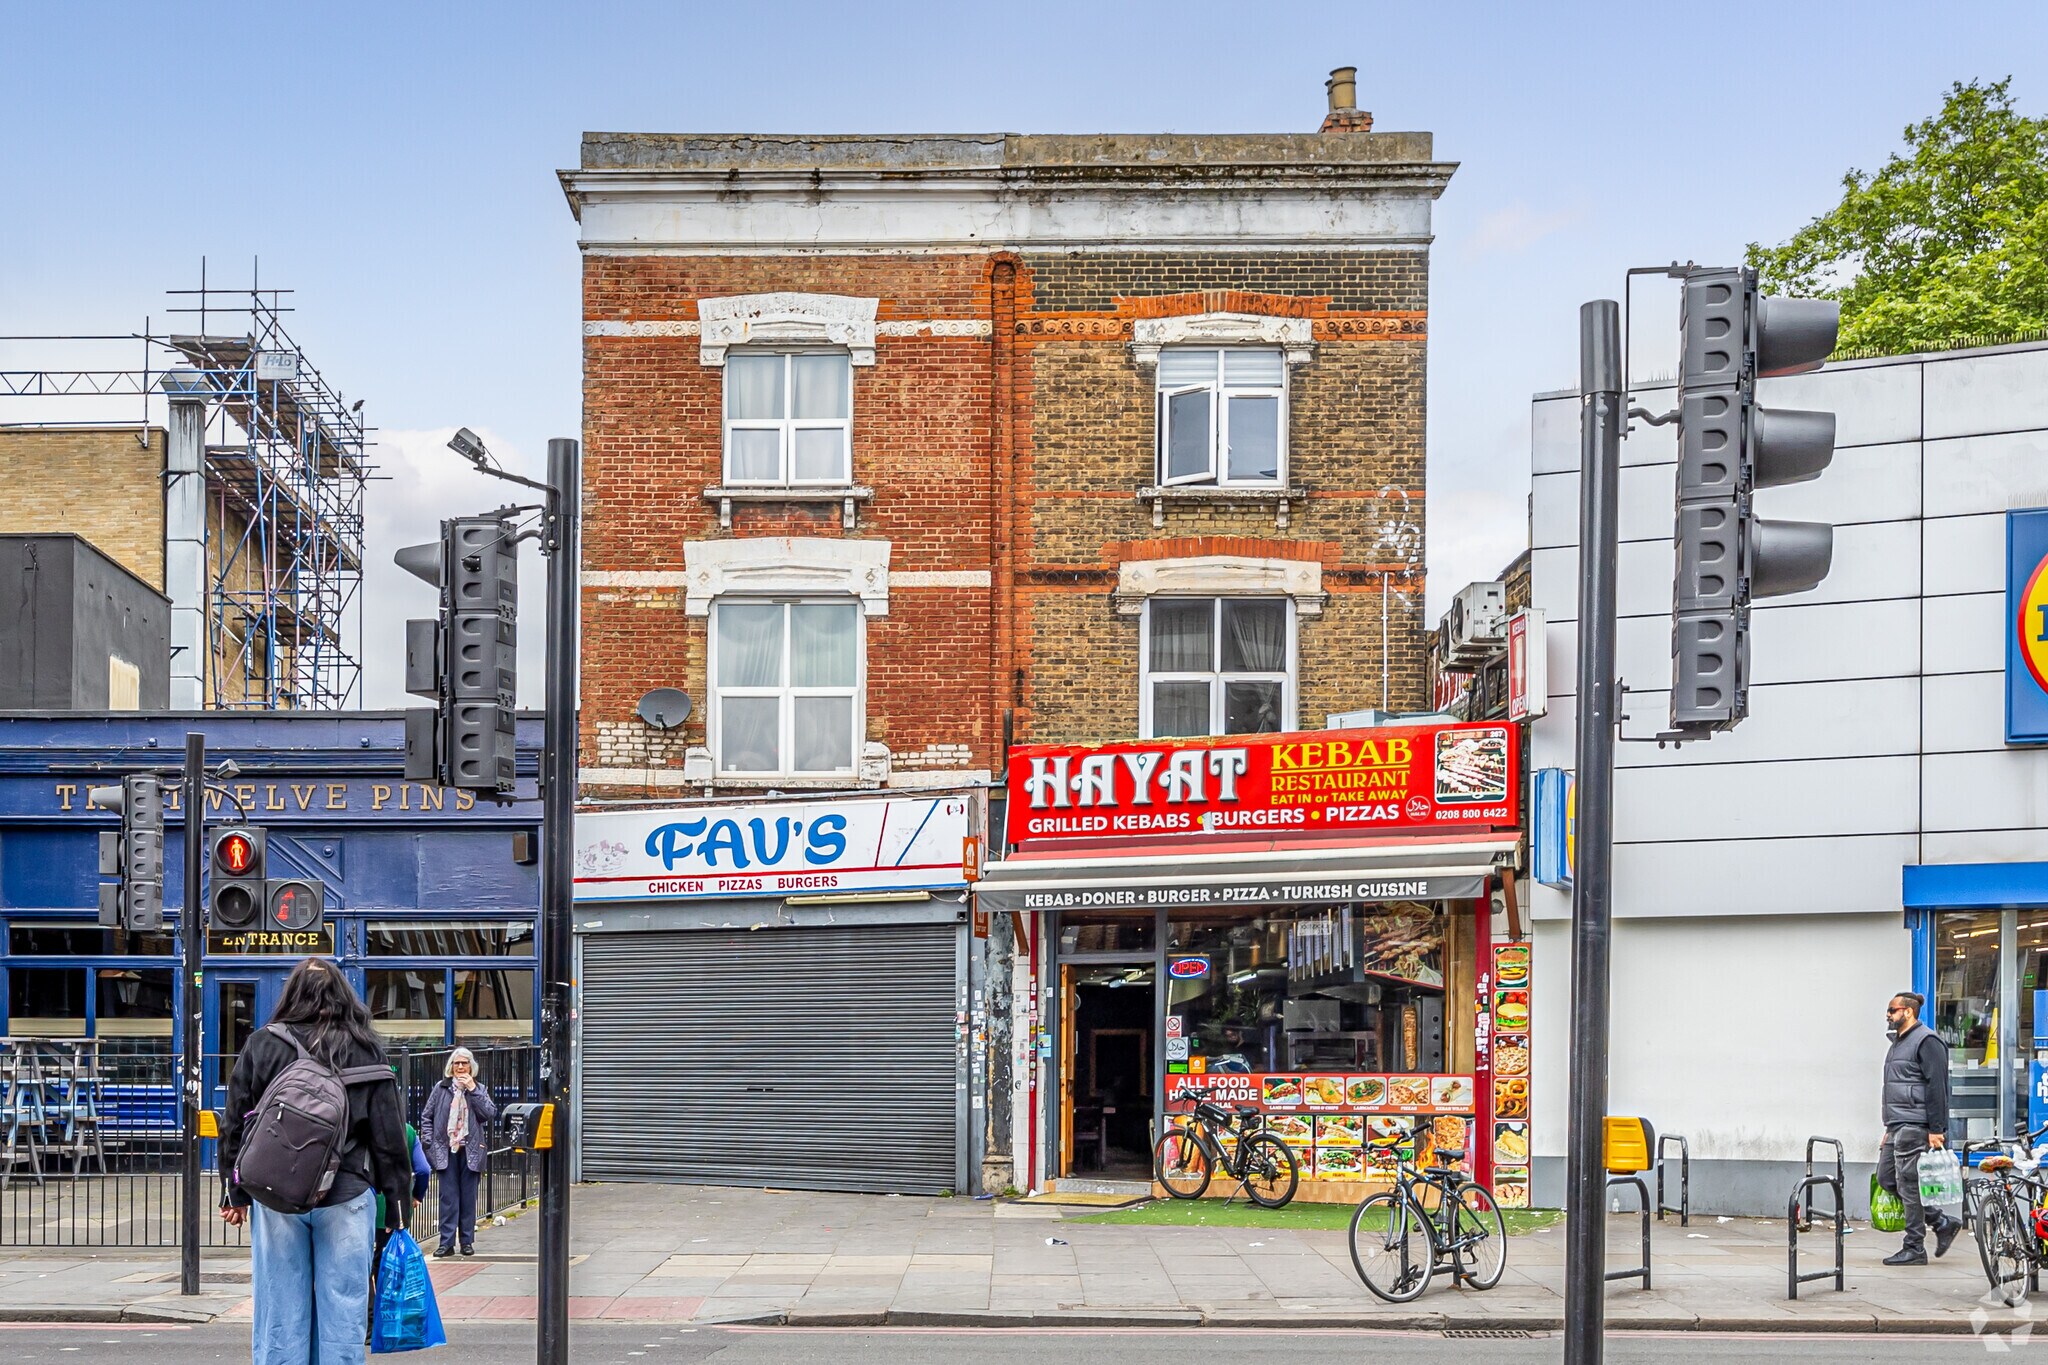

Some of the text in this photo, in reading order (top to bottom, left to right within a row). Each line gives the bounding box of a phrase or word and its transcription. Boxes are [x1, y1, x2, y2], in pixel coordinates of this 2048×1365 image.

[1511, 694, 1527, 716] OPEN
[1270, 738, 1413, 770] KEBAB
[1024, 748, 1248, 809] HAYAT
[1271, 770, 1411, 792] RESTAURANT
[371, 784, 476, 810] PINS
[1271, 789, 1408, 805] EAT IN or TAKE AWAY
[1028, 804, 1400, 834] GRILLED KEBABS BURGERS PIZZAS
[1435, 808, 1508, 820] 0208 800 6422
[648, 875, 838, 894] CHICKEN PIZZAS BURGERS
[1025, 881, 1428, 907] KEBAB DONER BURGER PIZZA TURKISH CUISINE
[222, 933, 319, 946] ENTRANCE
[1173, 961, 1206, 975] OPEN
[1176, 1076, 1250, 1089] ALL FOOD
[1215, 1089, 1258, 1101] MADE
[1877, 1211, 1906, 1220] REPEA
